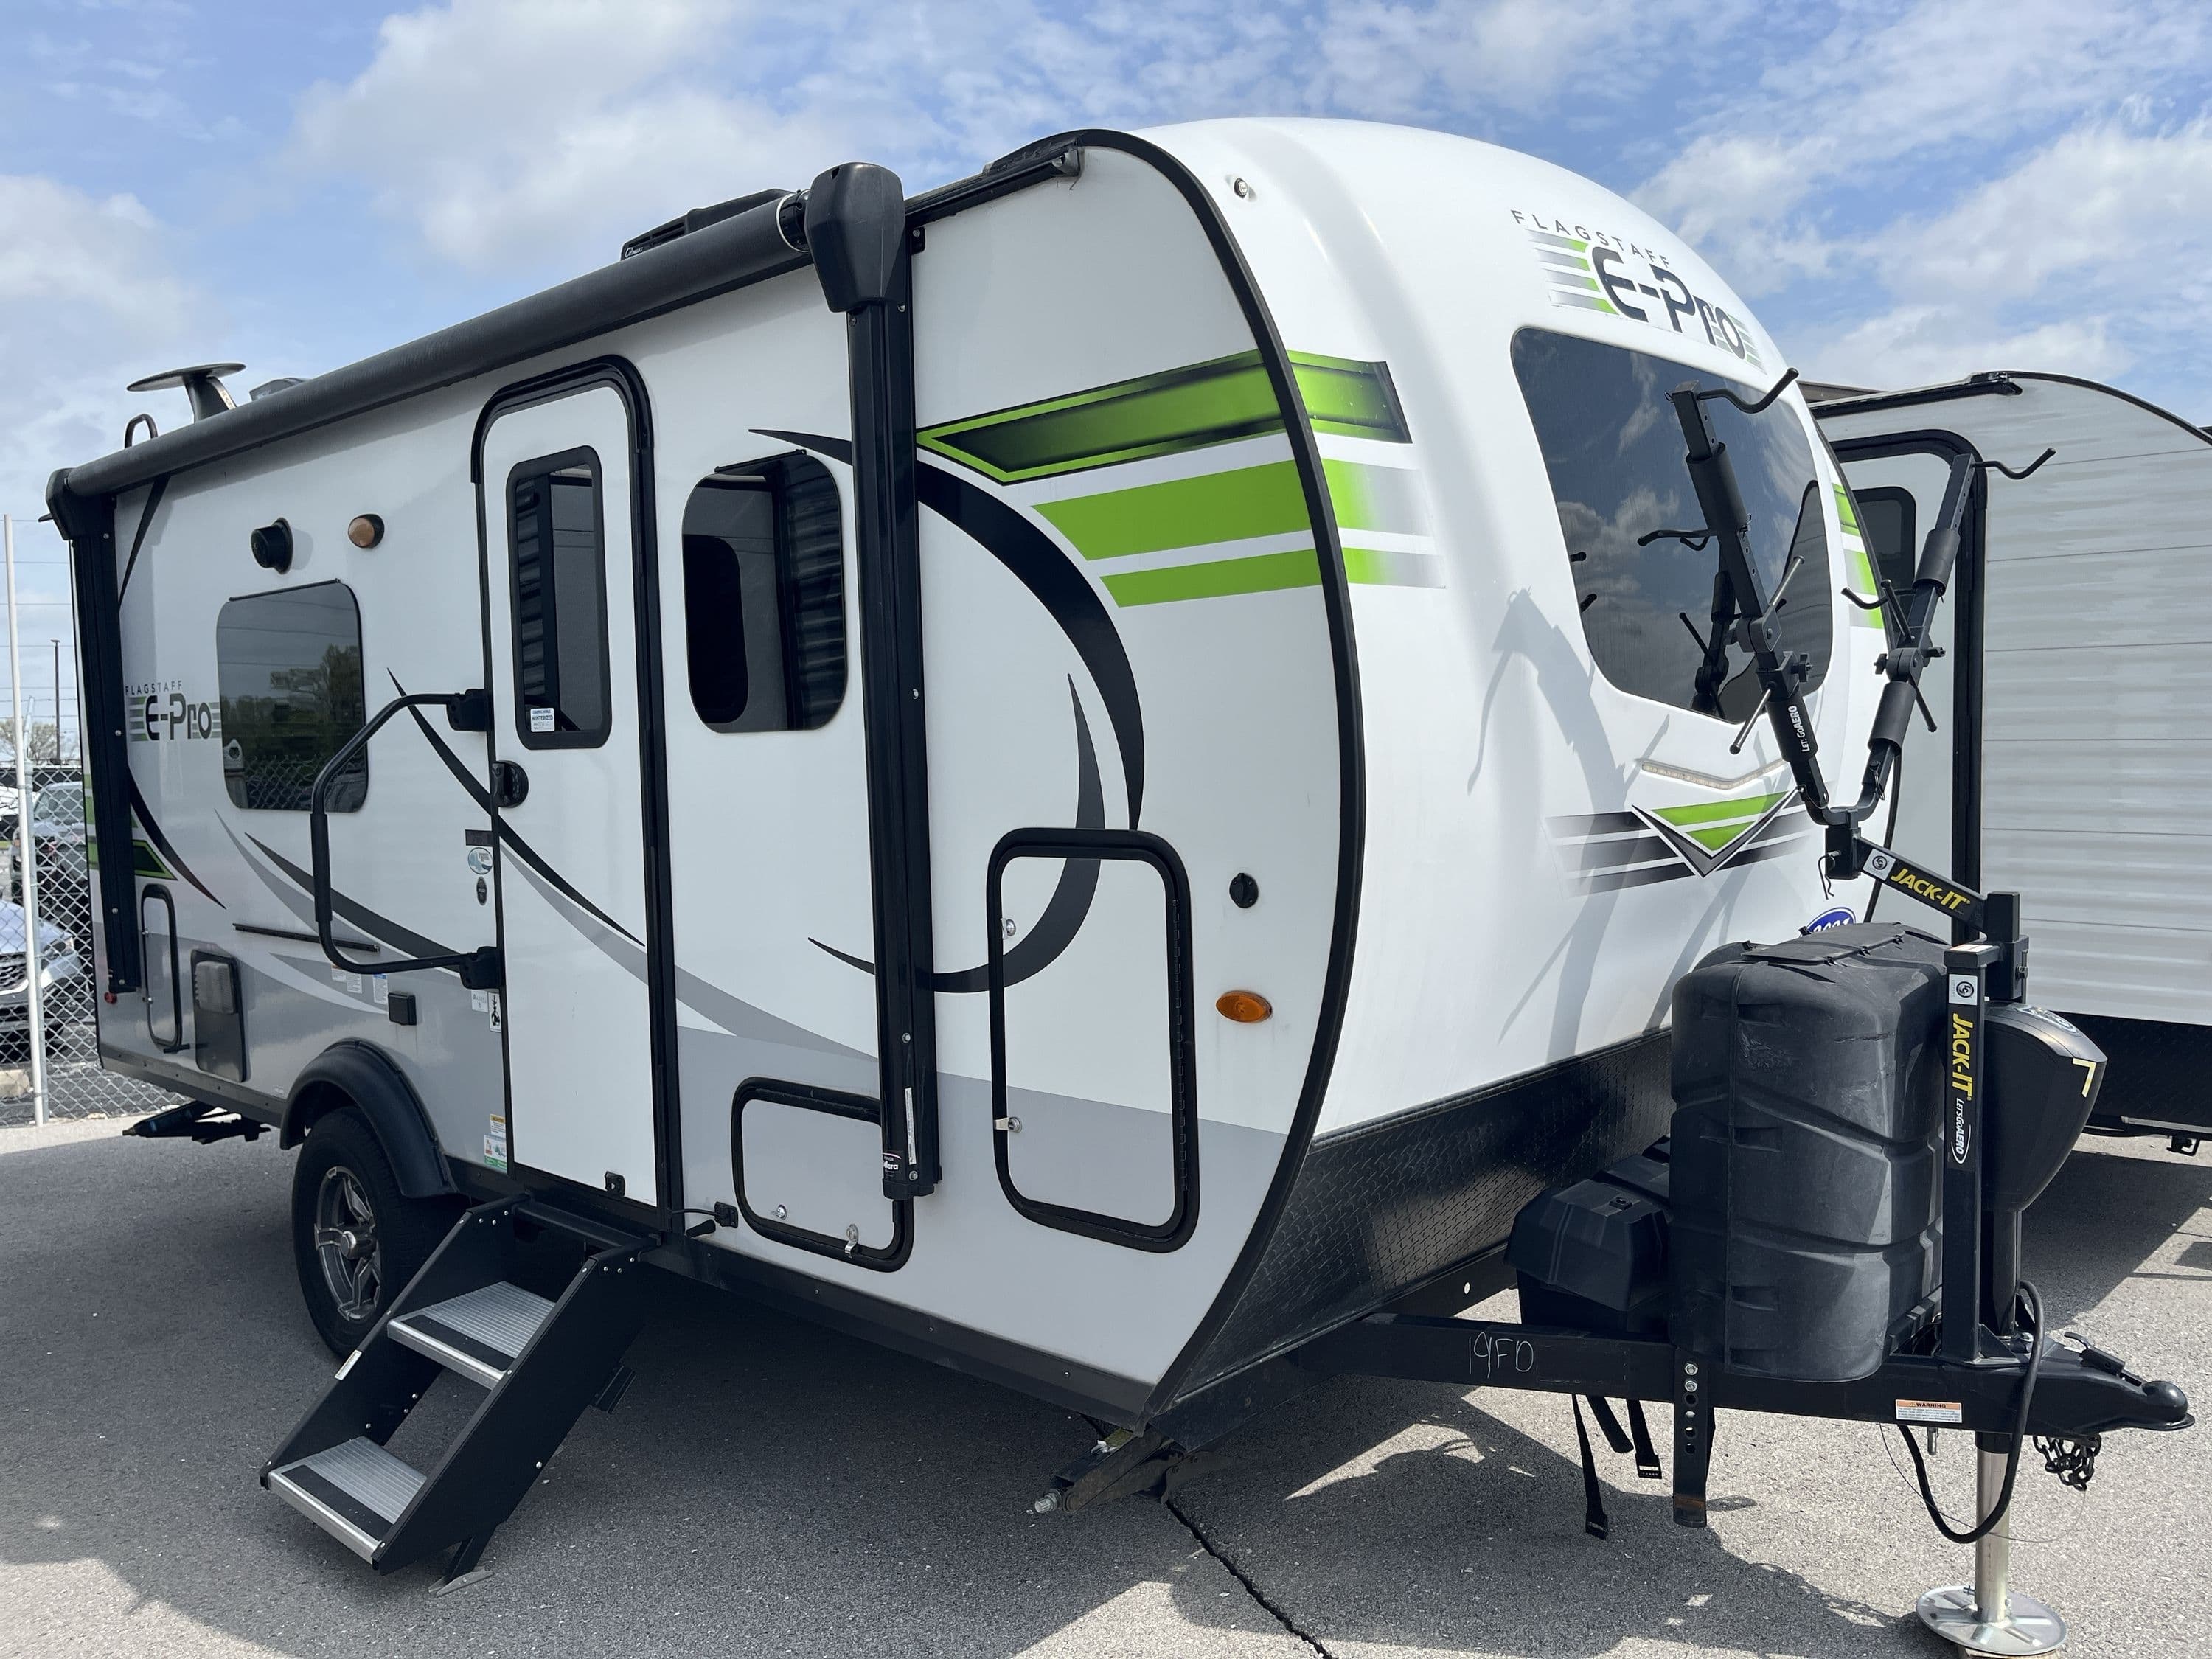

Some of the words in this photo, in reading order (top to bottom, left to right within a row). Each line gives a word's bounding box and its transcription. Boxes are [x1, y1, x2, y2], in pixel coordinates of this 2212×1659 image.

[1511, 209, 1669, 268] FLAGSTAFF
[125, 680, 182, 695] FLAGSTAFF
[1891, 868, 1968, 910] JACK-IT
[1952, 1013, 1973, 1097] JACK-IT
